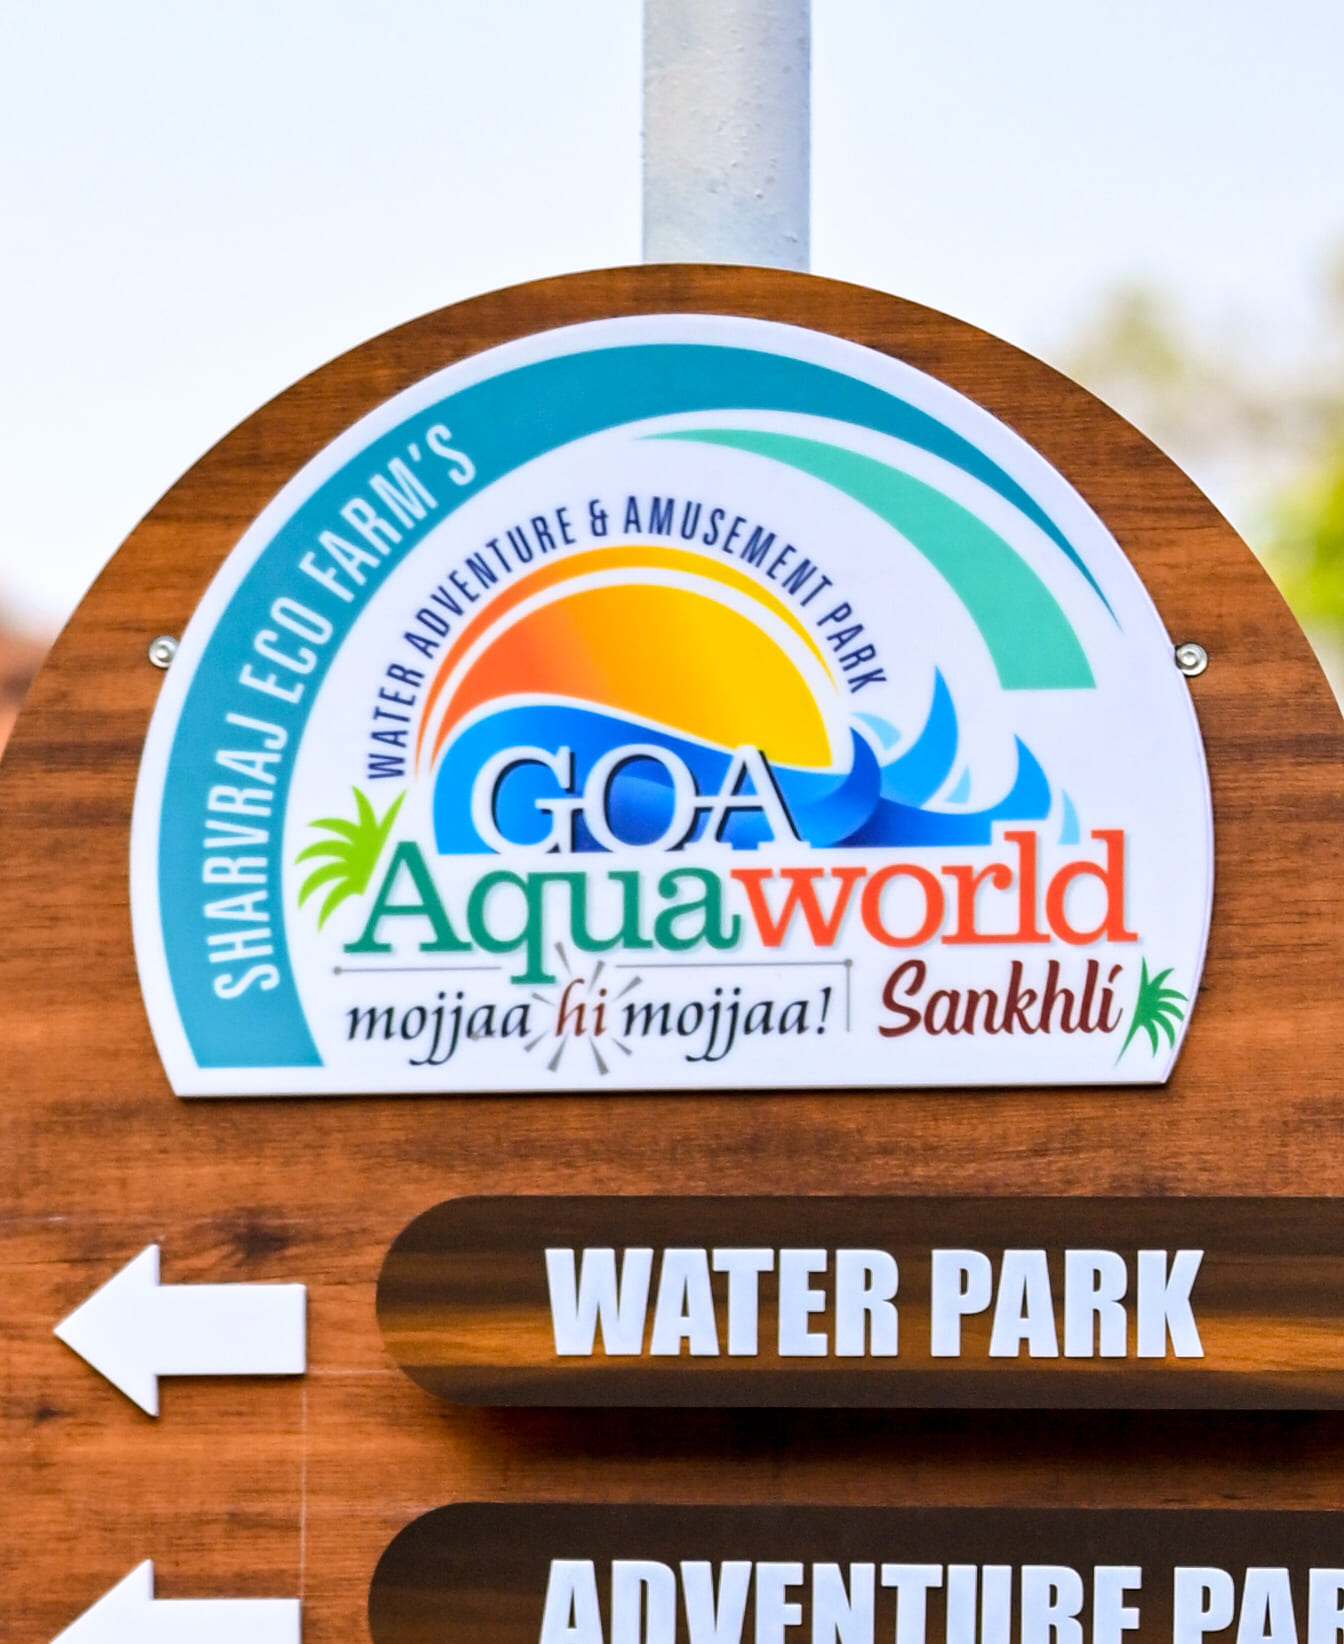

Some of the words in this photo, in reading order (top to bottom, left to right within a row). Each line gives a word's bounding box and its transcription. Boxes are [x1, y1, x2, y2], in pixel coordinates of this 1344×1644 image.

[298, 423, 478, 603] FARM'S
[238, 597, 334, 706] ECO
[367, 661, 426, 780] WATER
[402, 506, 577, 660] ADVENTURE
[589, 499, 609, 538] &
[622, 496, 833, 608] AMUSEMENT
[816, 600, 888, 694] PARK
[202, 711, 289, 1000] SHARVRAJ
[471, 743, 812, 854] GOA
[342, 827, 1140, 985] Aquaworld
[346, 992, 532, 1067] mojjaa
[554, 978, 608, 1039] hi
[621, 986, 833, 1064] mojjaa!
[545, 1248, 898, 1356] WATER
[931, 1250, 1204, 1357] PARK
